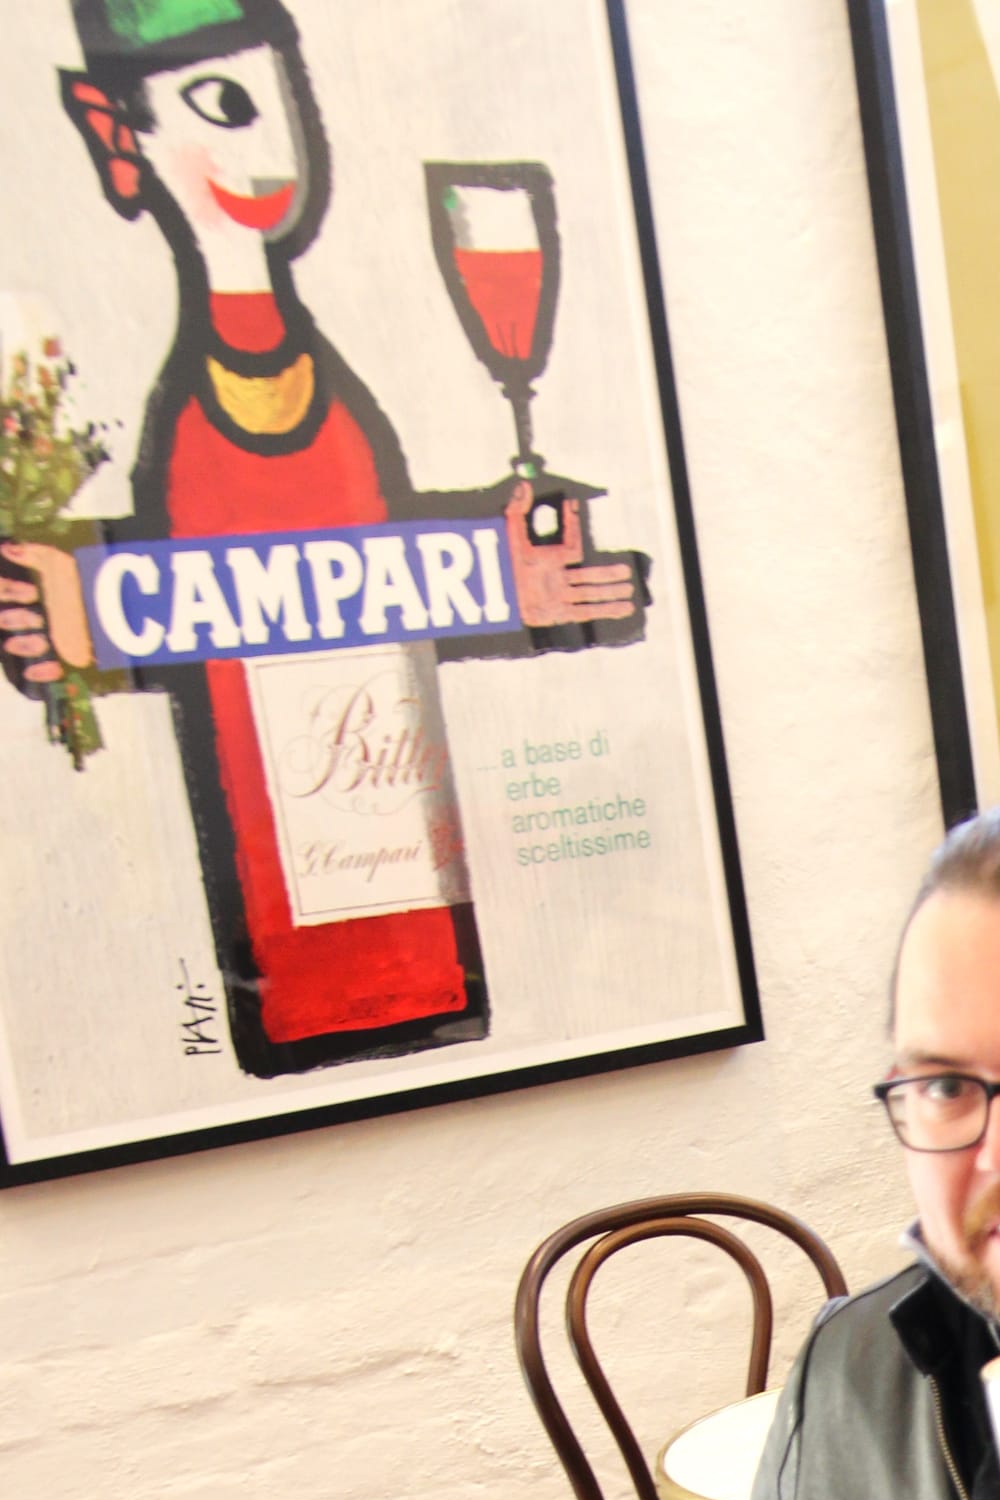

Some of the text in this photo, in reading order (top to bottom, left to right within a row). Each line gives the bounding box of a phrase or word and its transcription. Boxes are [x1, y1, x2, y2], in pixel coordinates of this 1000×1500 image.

[94, 528, 512, 657] CAMPARI
[524, 738, 582, 766] base
[589, 729, 611, 758] di
[506, 771, 561, 801] erbe
[512, 792, 647, 834] aromatiche
[517, 826, 651, 867] sceltissime
